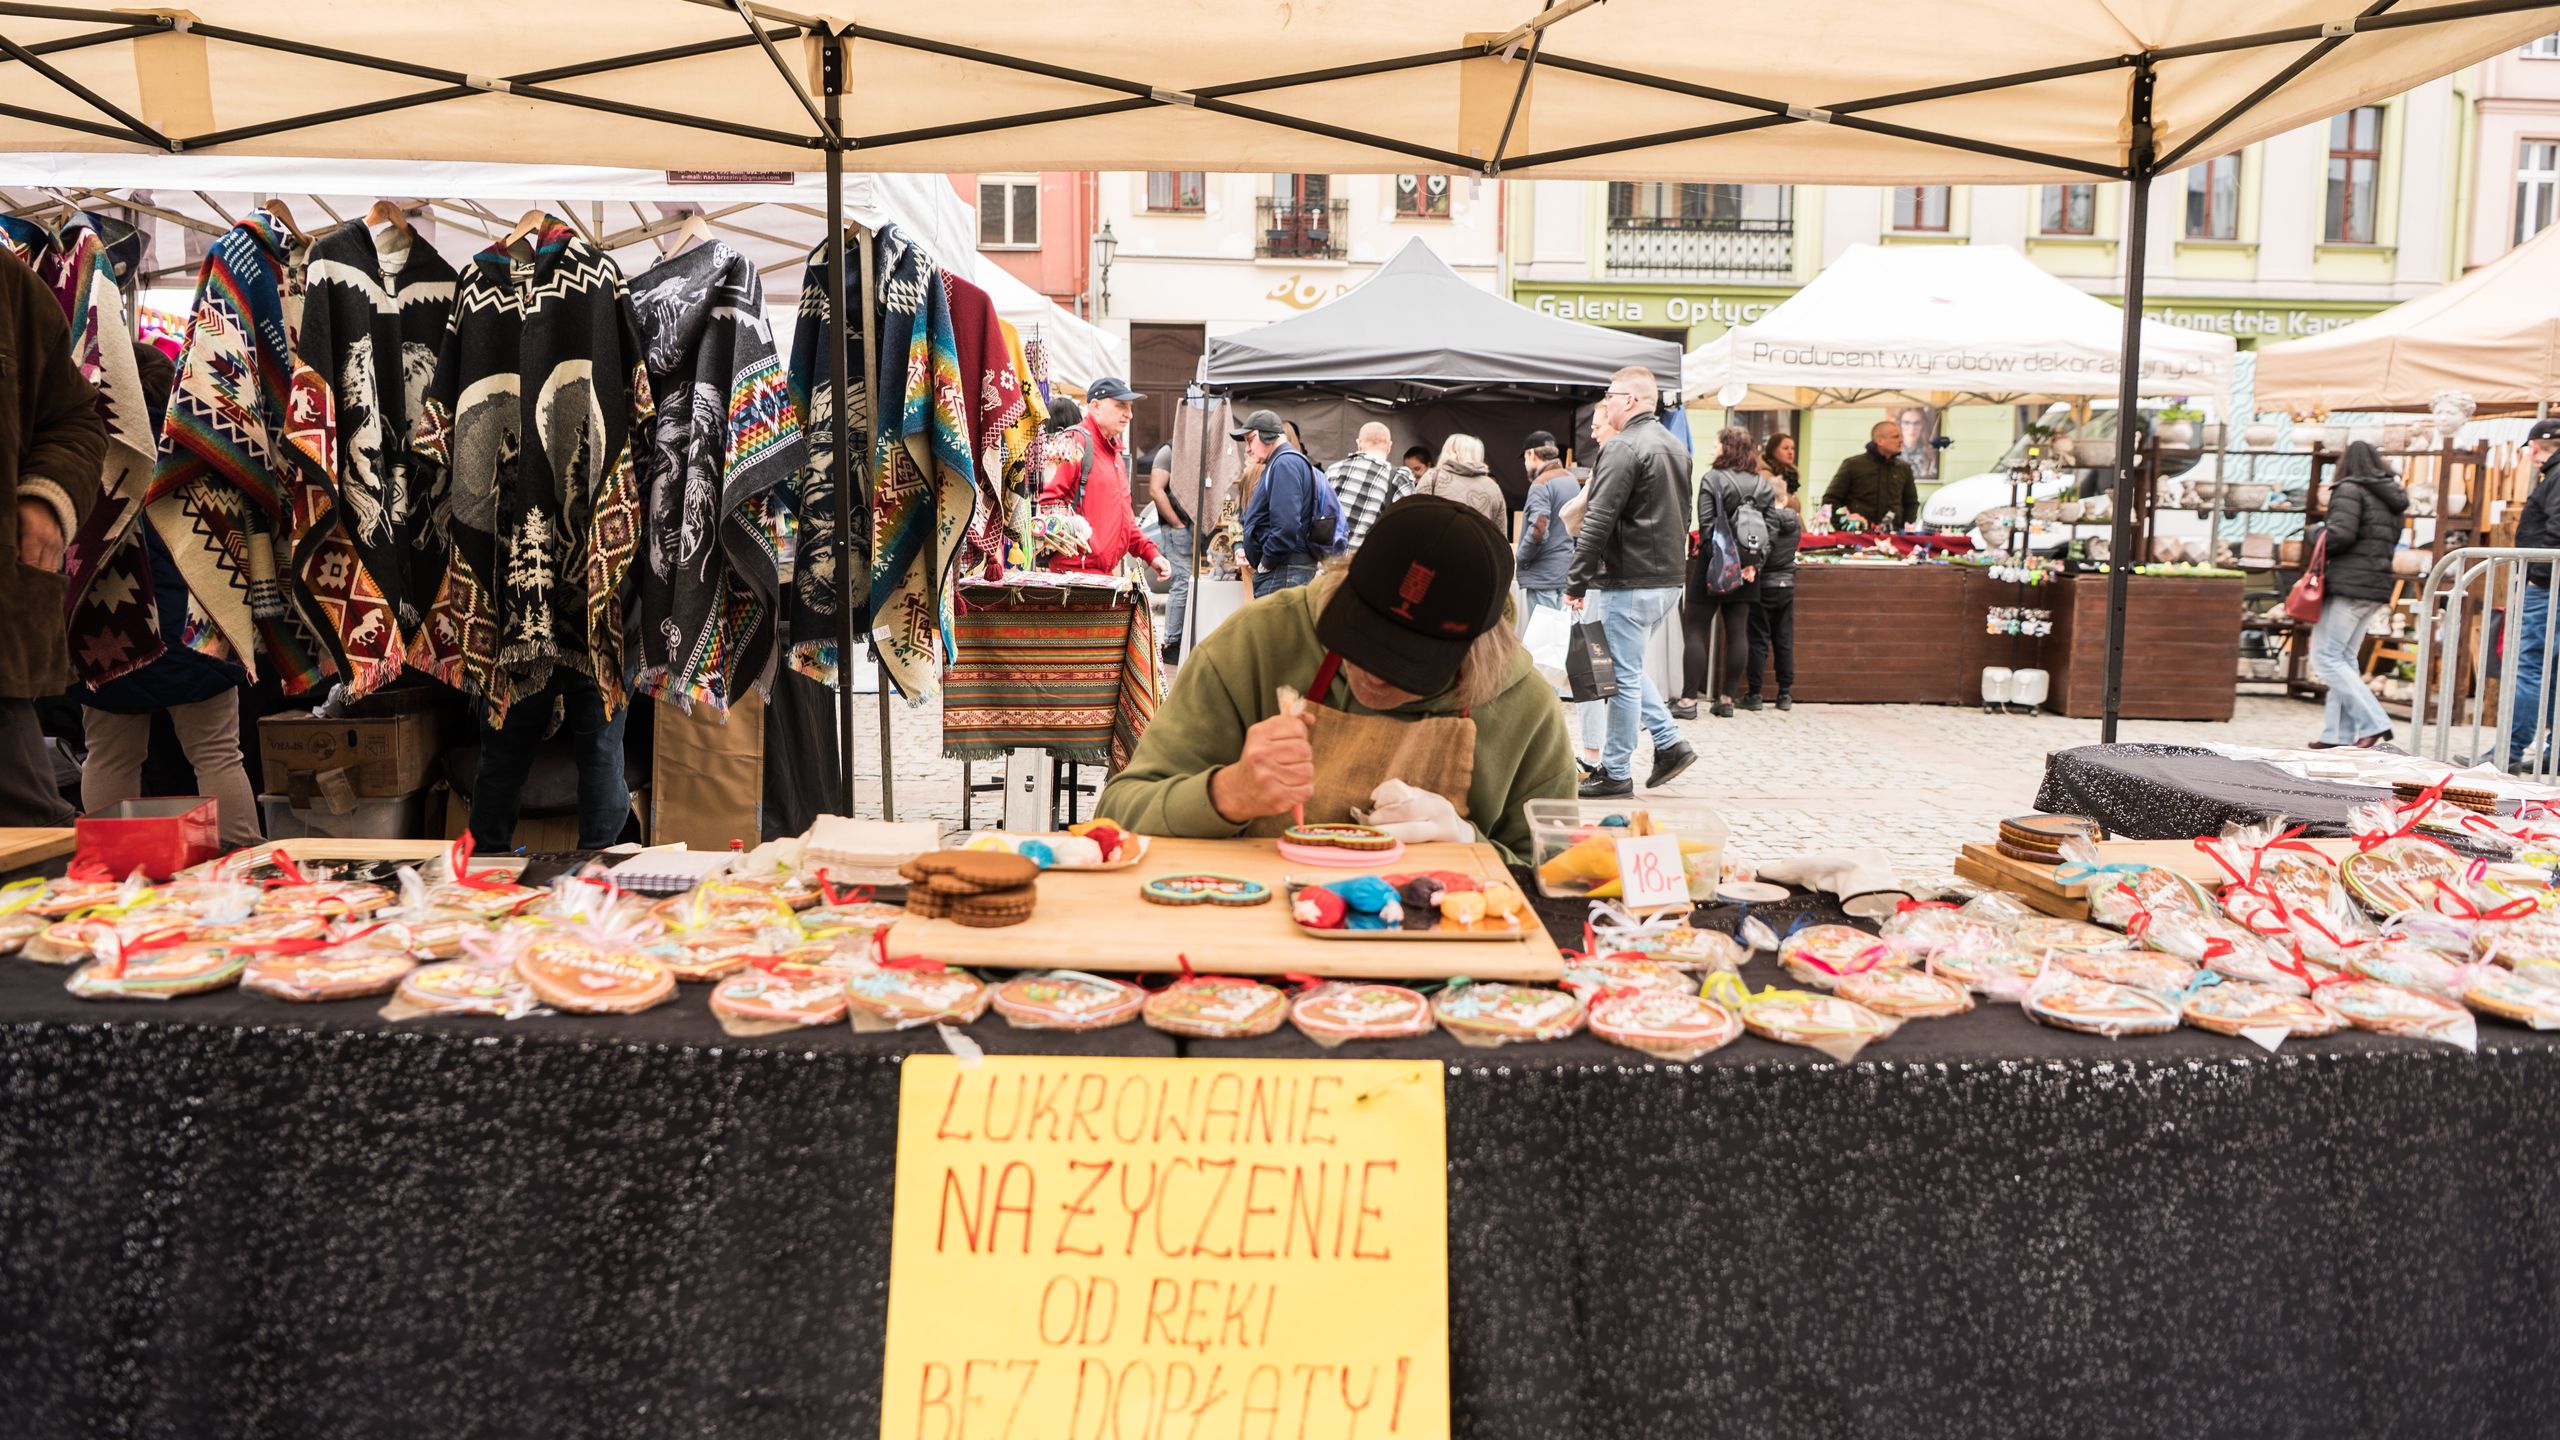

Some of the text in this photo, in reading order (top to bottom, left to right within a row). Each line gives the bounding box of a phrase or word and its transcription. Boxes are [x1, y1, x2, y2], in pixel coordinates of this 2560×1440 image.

[1534, 294, 1643, 321] Galeria
[1753, 342, 1886, 368] Producent
[1893, 348, 2016, 375] wyrobów
[937, 1072, 1344, 1146] LUKROWANIE
[937, 1159, 1036, 1255] NA
[1038, 1273, 1277, 1355] OD RĘKI
[915, 1355, 1413, 1440] BEZ DOPŁATY!
